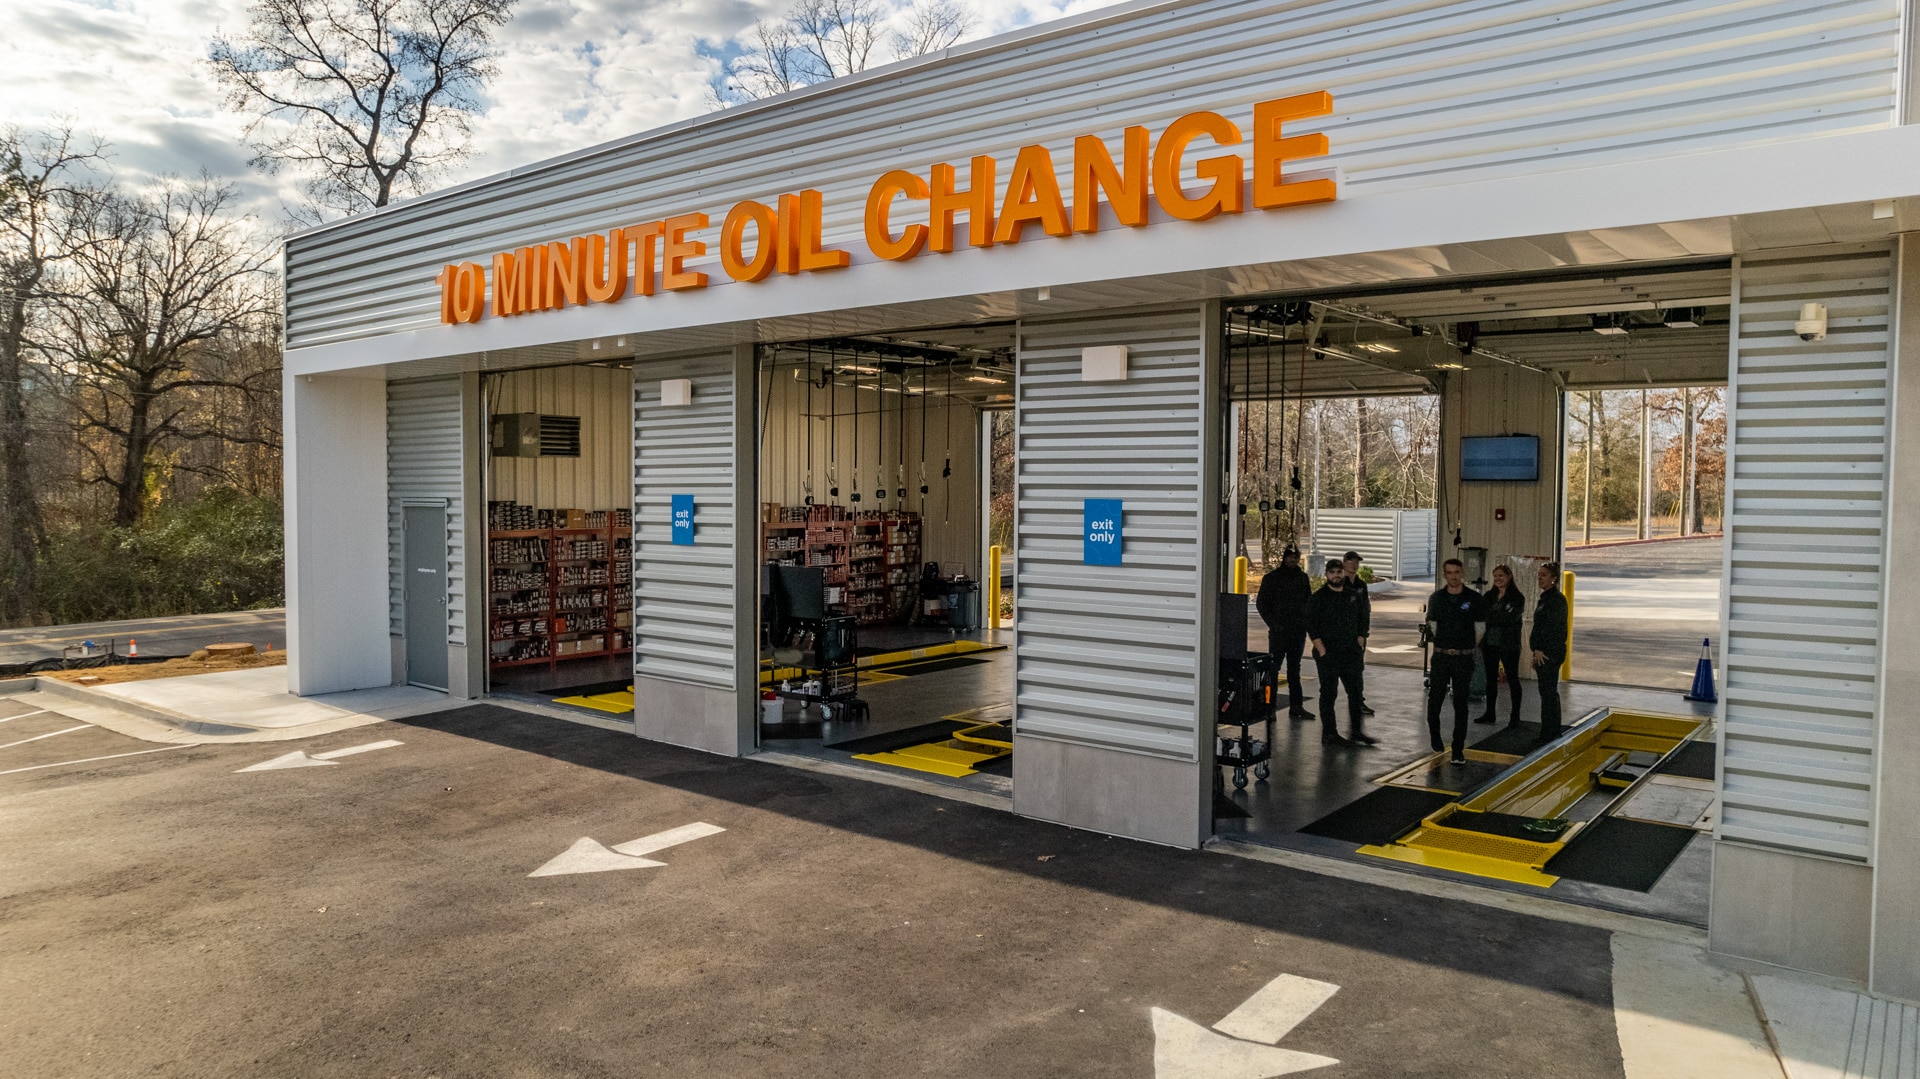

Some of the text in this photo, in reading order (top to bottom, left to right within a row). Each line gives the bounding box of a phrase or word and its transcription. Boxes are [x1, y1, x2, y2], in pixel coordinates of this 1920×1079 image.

[435, 90, 1337, 325] 10 MINUTE OIL CHANGE
[675, 509, 689, 518] exit
[674, 519, 690, 529] only
[1091, 518, 1114, 530] exit
[1089, 531, 1115, 544] only
